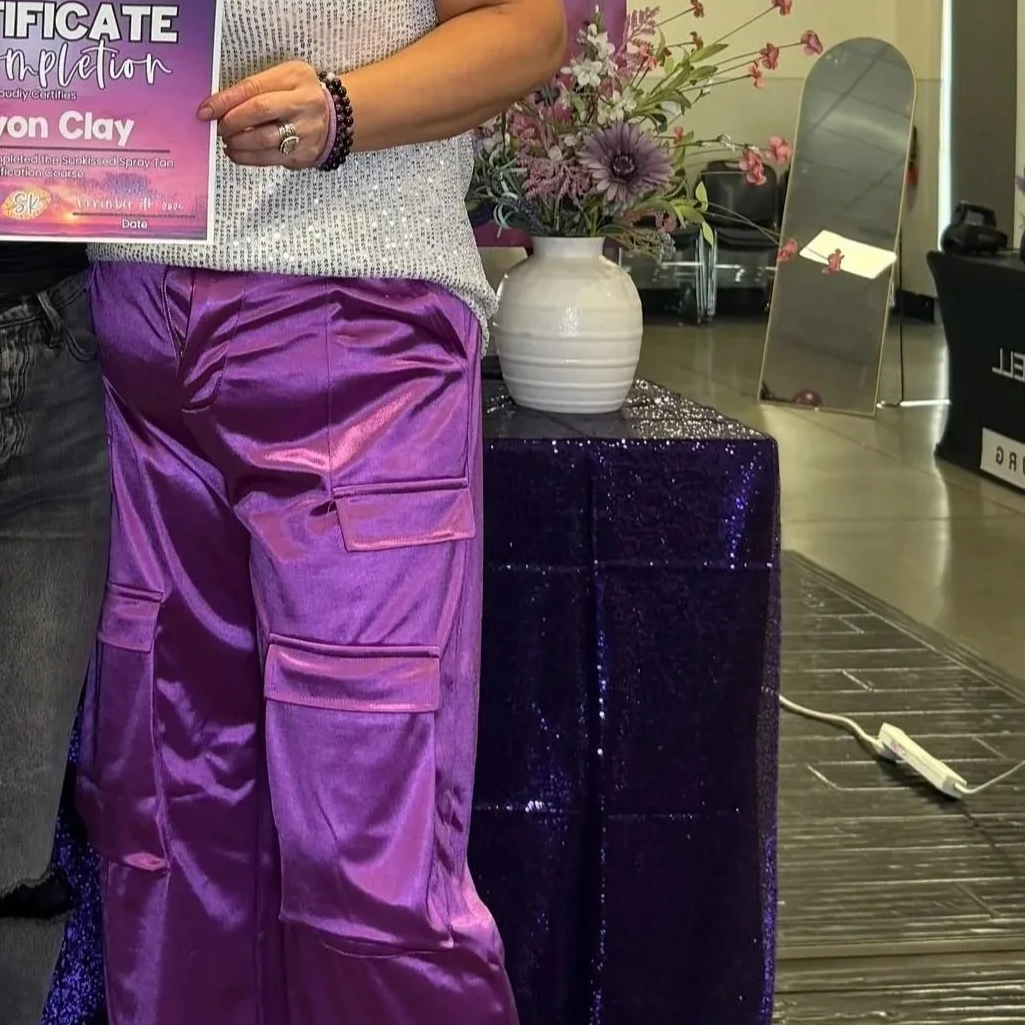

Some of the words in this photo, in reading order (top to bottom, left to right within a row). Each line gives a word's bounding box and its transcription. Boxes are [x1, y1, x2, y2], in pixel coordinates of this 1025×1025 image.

[31, 90, 77, 101] Certifies
[59, 110, 134, 147] Clay
[41, 155, 59, 165] the
[61, 155, 117, 167] Sunkissed
[119, 157, 151, 170] Spray
[153, 158, 174, 168] Tan
[44, 168, 84, 179] Course
[121, 219, 148, 230] Date
